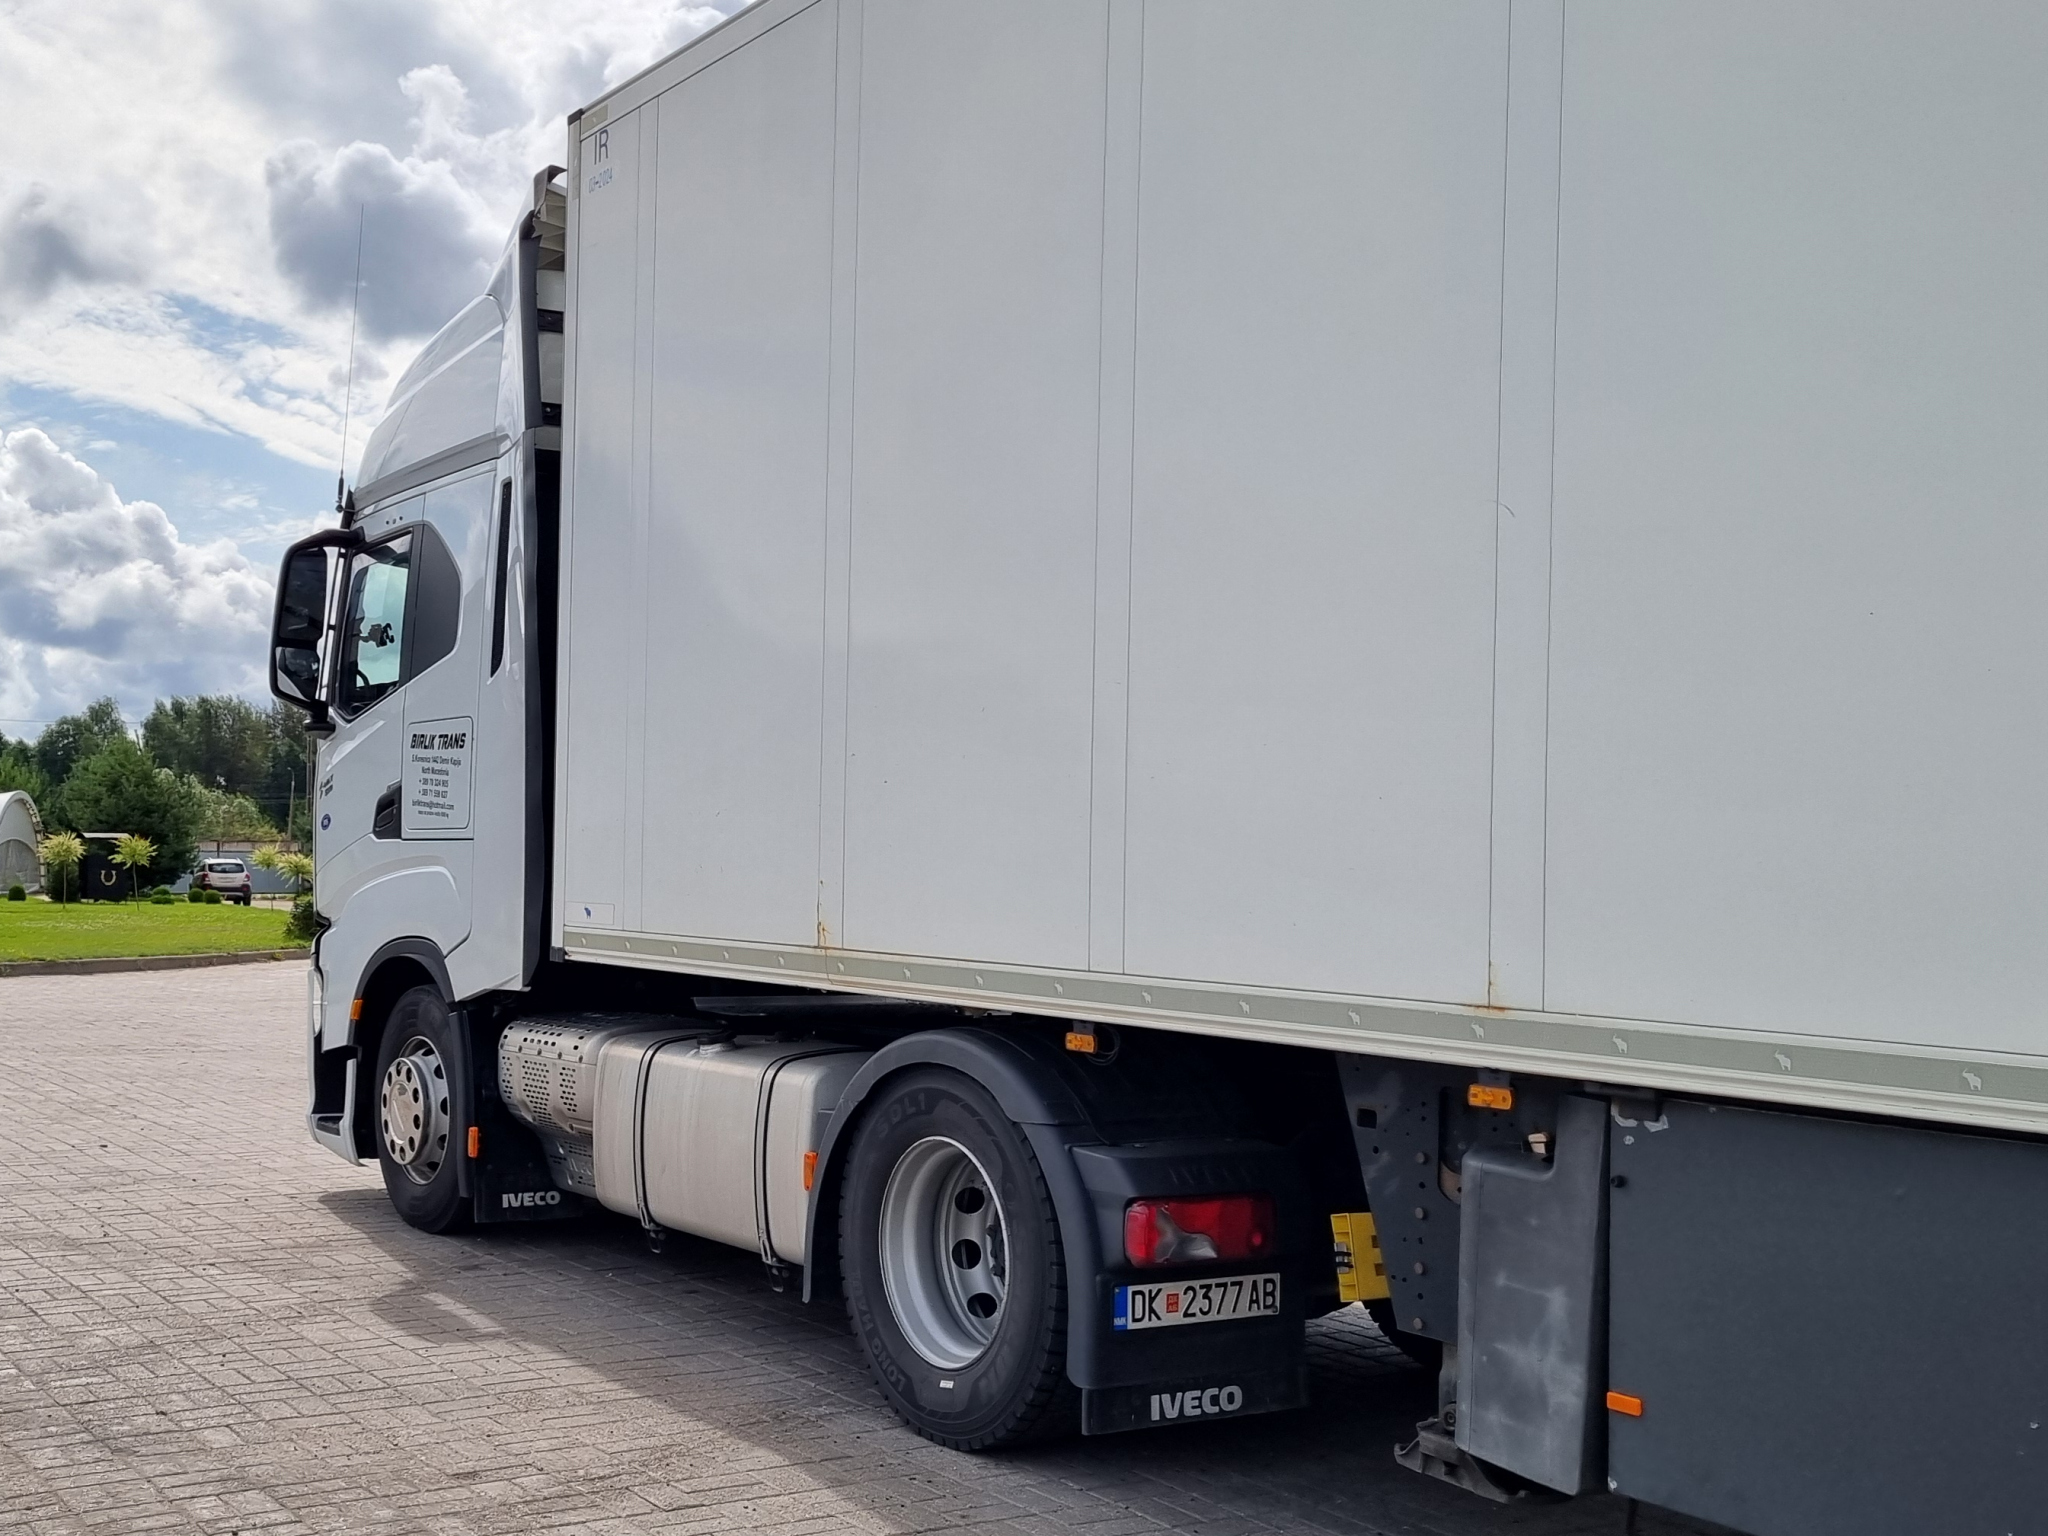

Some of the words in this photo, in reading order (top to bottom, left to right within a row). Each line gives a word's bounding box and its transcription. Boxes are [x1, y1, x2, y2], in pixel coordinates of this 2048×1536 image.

[594, 129, 609, 165] IR
[410, 733, 437, 750] BIRLIK
[437, 732, 467, 750] TRANS
[502, 1190, 561, 1208] IVECO
[1131, 1288, 1162, 1323] DK
[1183, 1280, 1244, 1318] 2377
[1248, 1277, 1277, 1312] AB
[1150, 1385, 1243, 1421] IVECO
